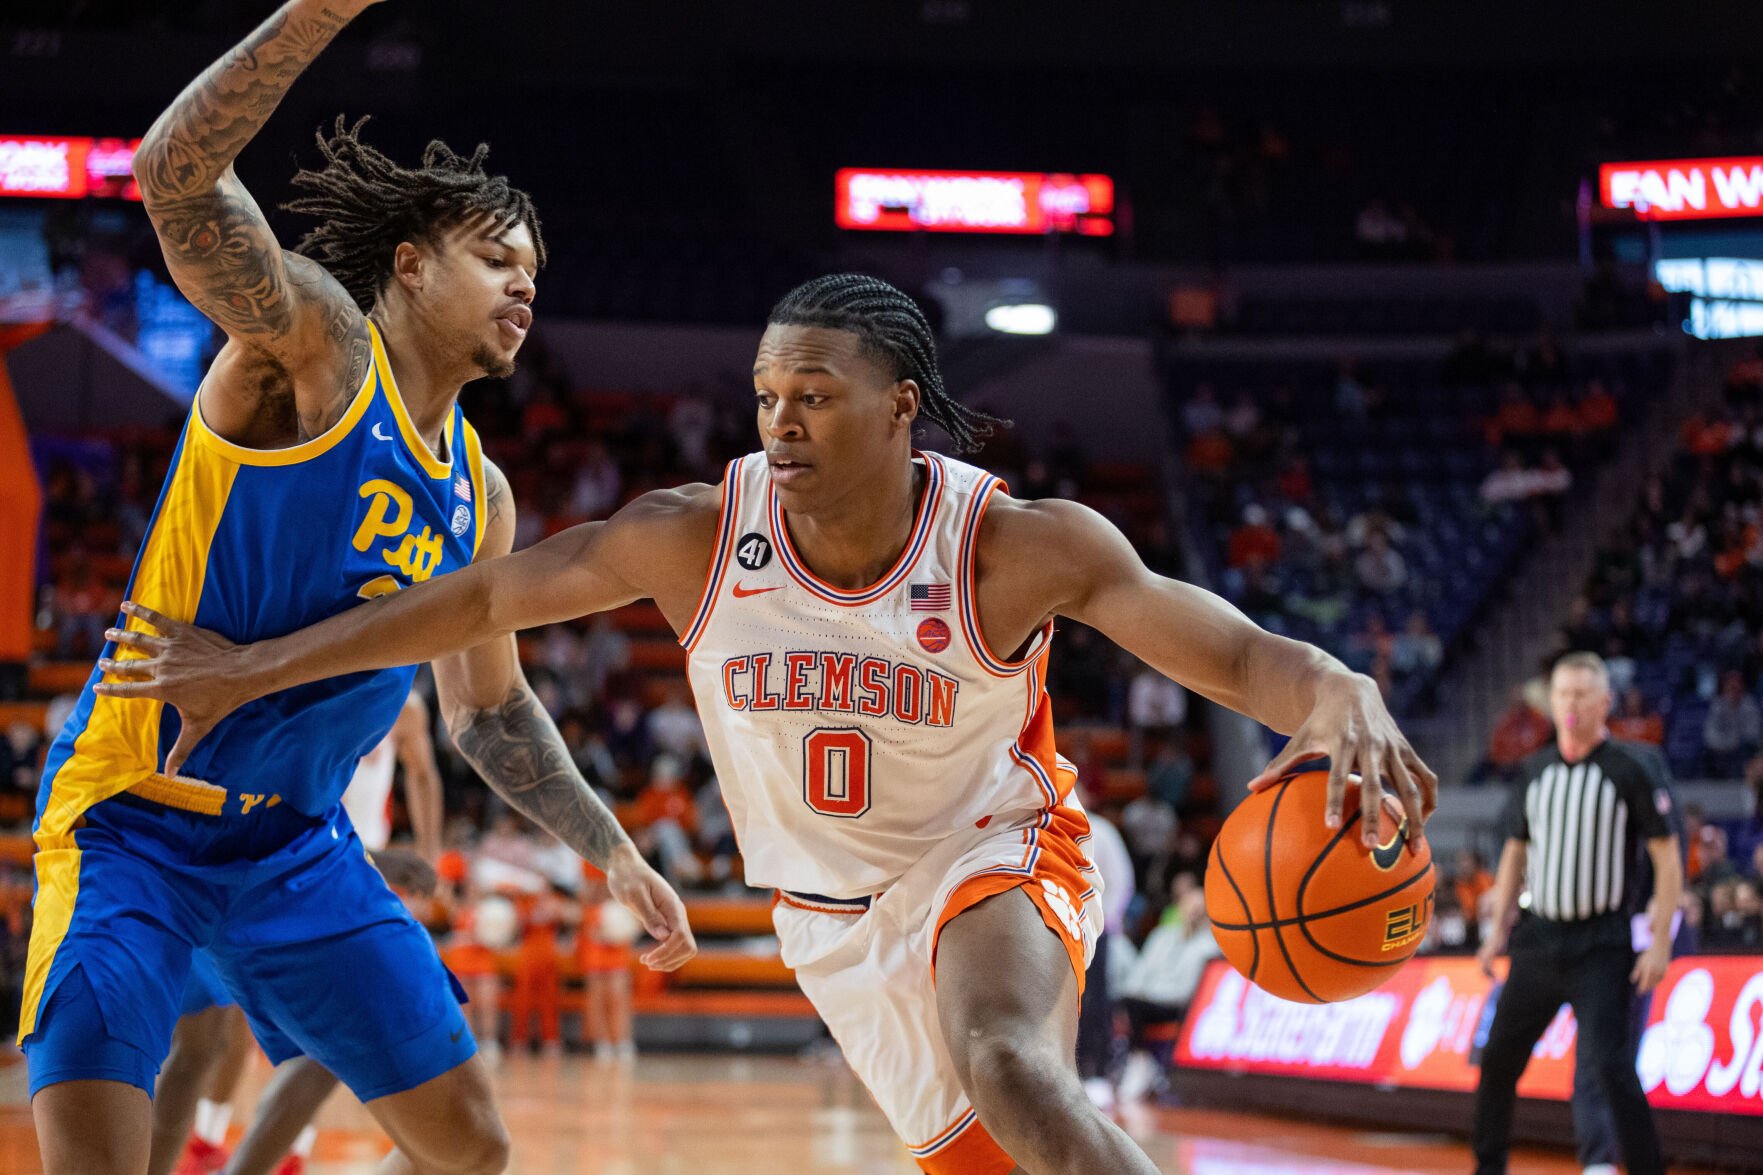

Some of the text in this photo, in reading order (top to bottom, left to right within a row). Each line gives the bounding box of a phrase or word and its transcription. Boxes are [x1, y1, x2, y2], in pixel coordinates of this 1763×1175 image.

[1611, 167, 1706, 212] FAN
[353, 479, 444, 582] Pitt
[738, 539, 767, 566] 41
[722, 652, 959, 727] CLEMSON
[804, 728, 871, 817] 0
